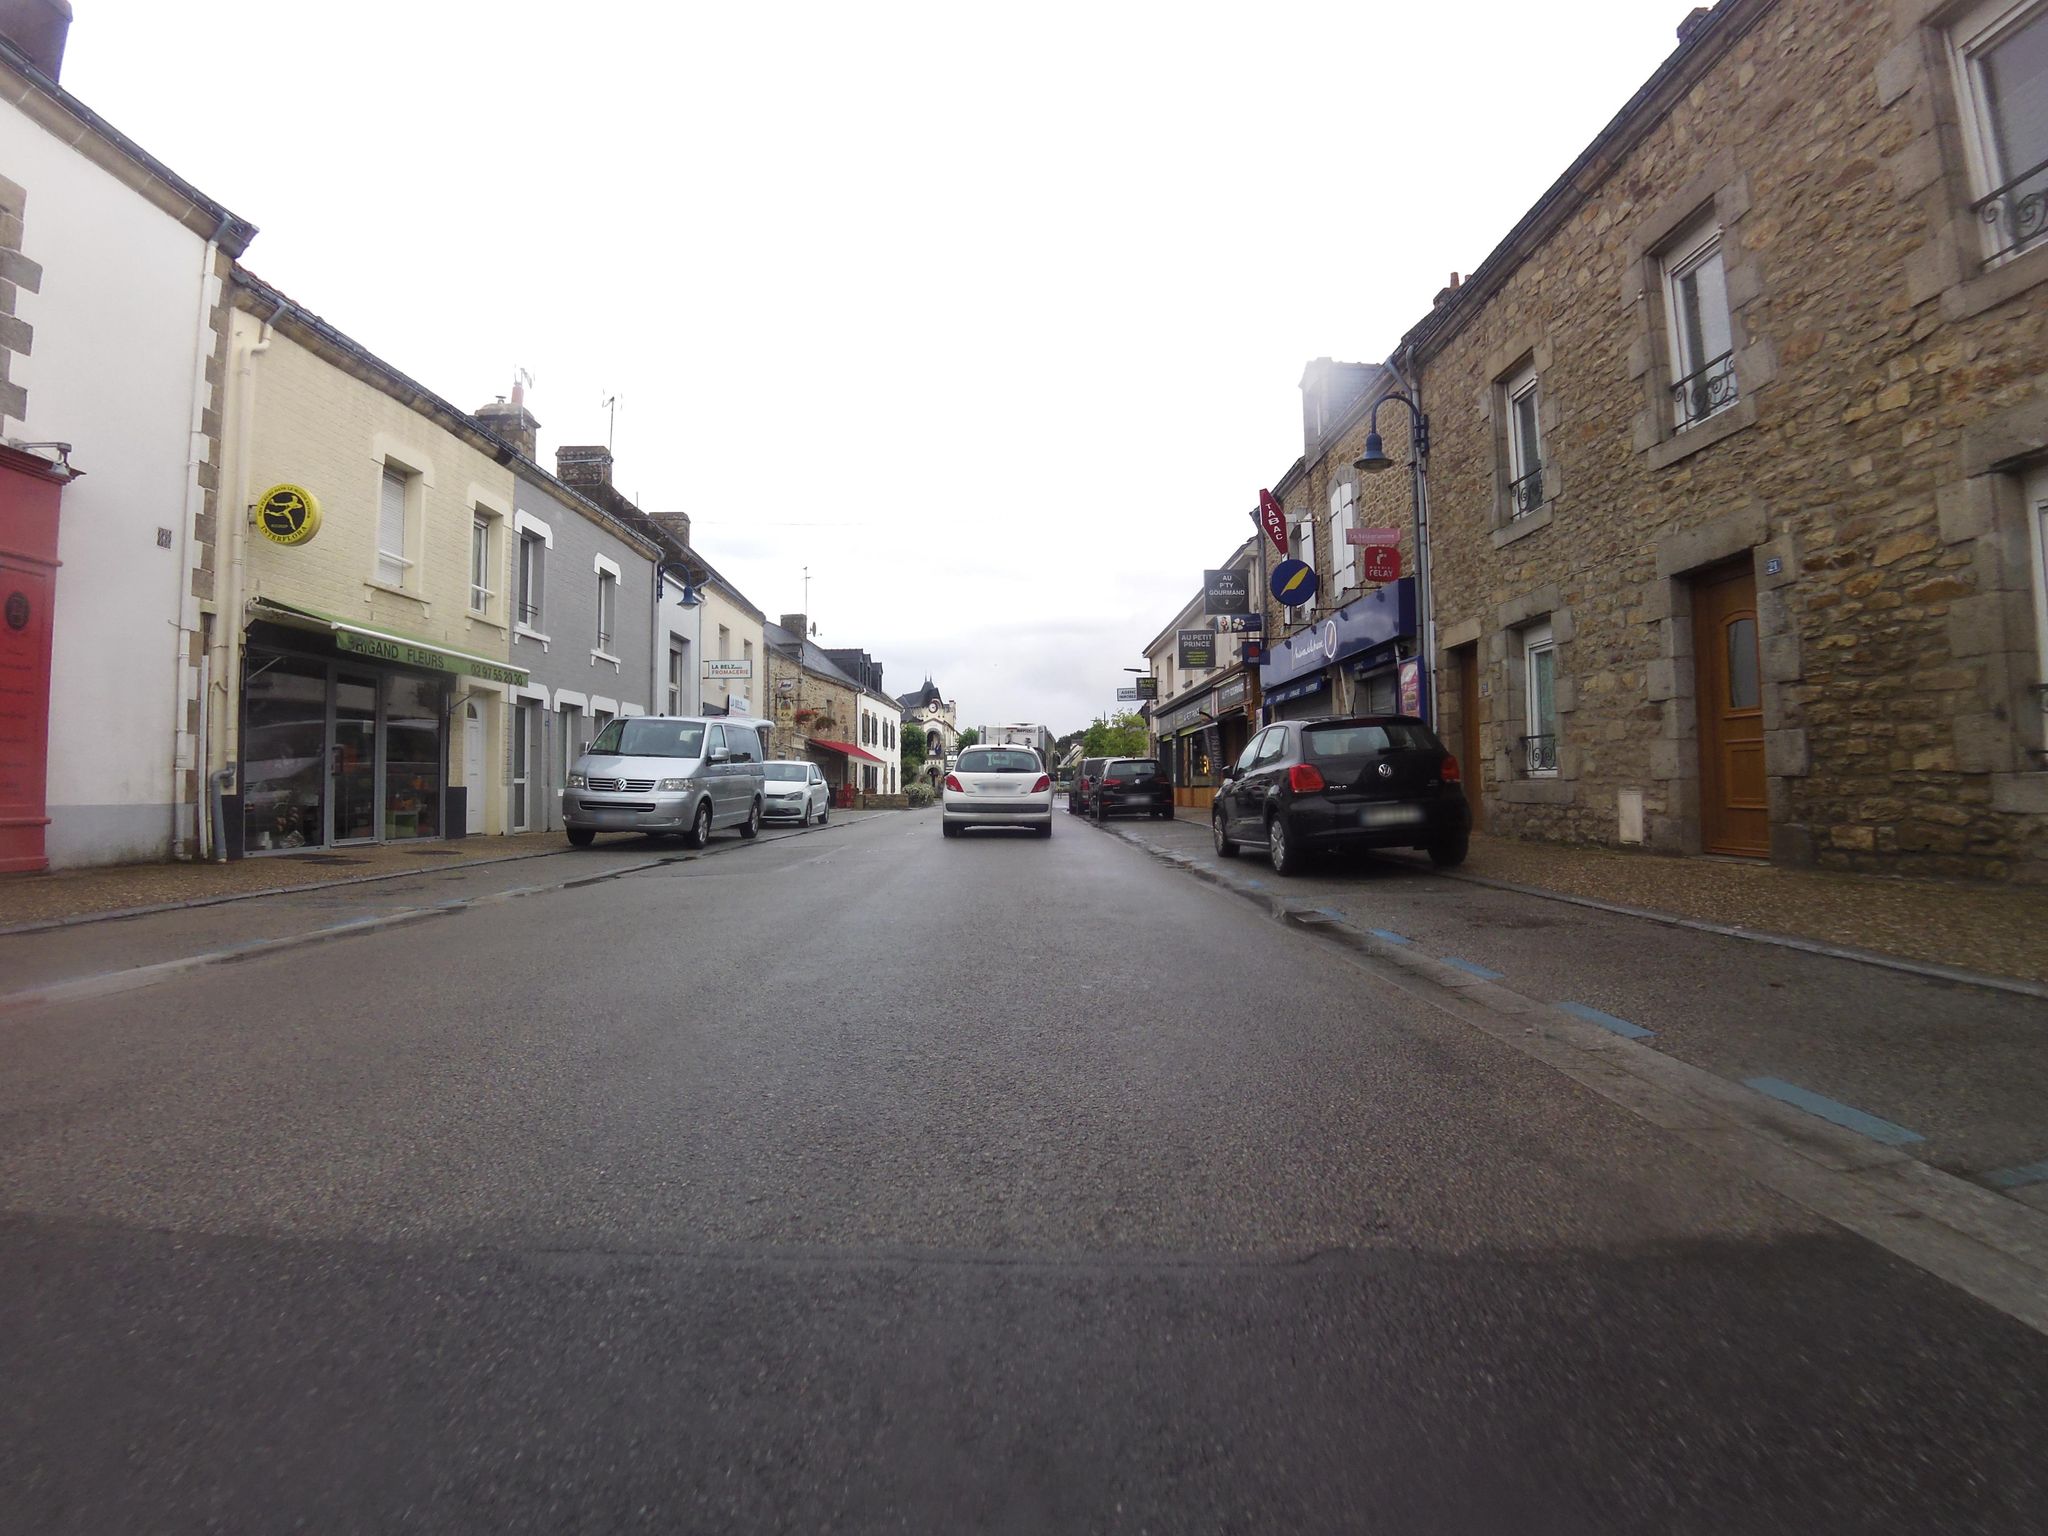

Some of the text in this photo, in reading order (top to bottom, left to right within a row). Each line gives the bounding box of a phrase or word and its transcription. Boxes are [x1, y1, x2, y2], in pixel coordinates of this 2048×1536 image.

[1265, 503, 1283, 540] TABAC
[261, 525, 307, 542] INTERFLORA
[407, 649, 444, 669] FLEURS
